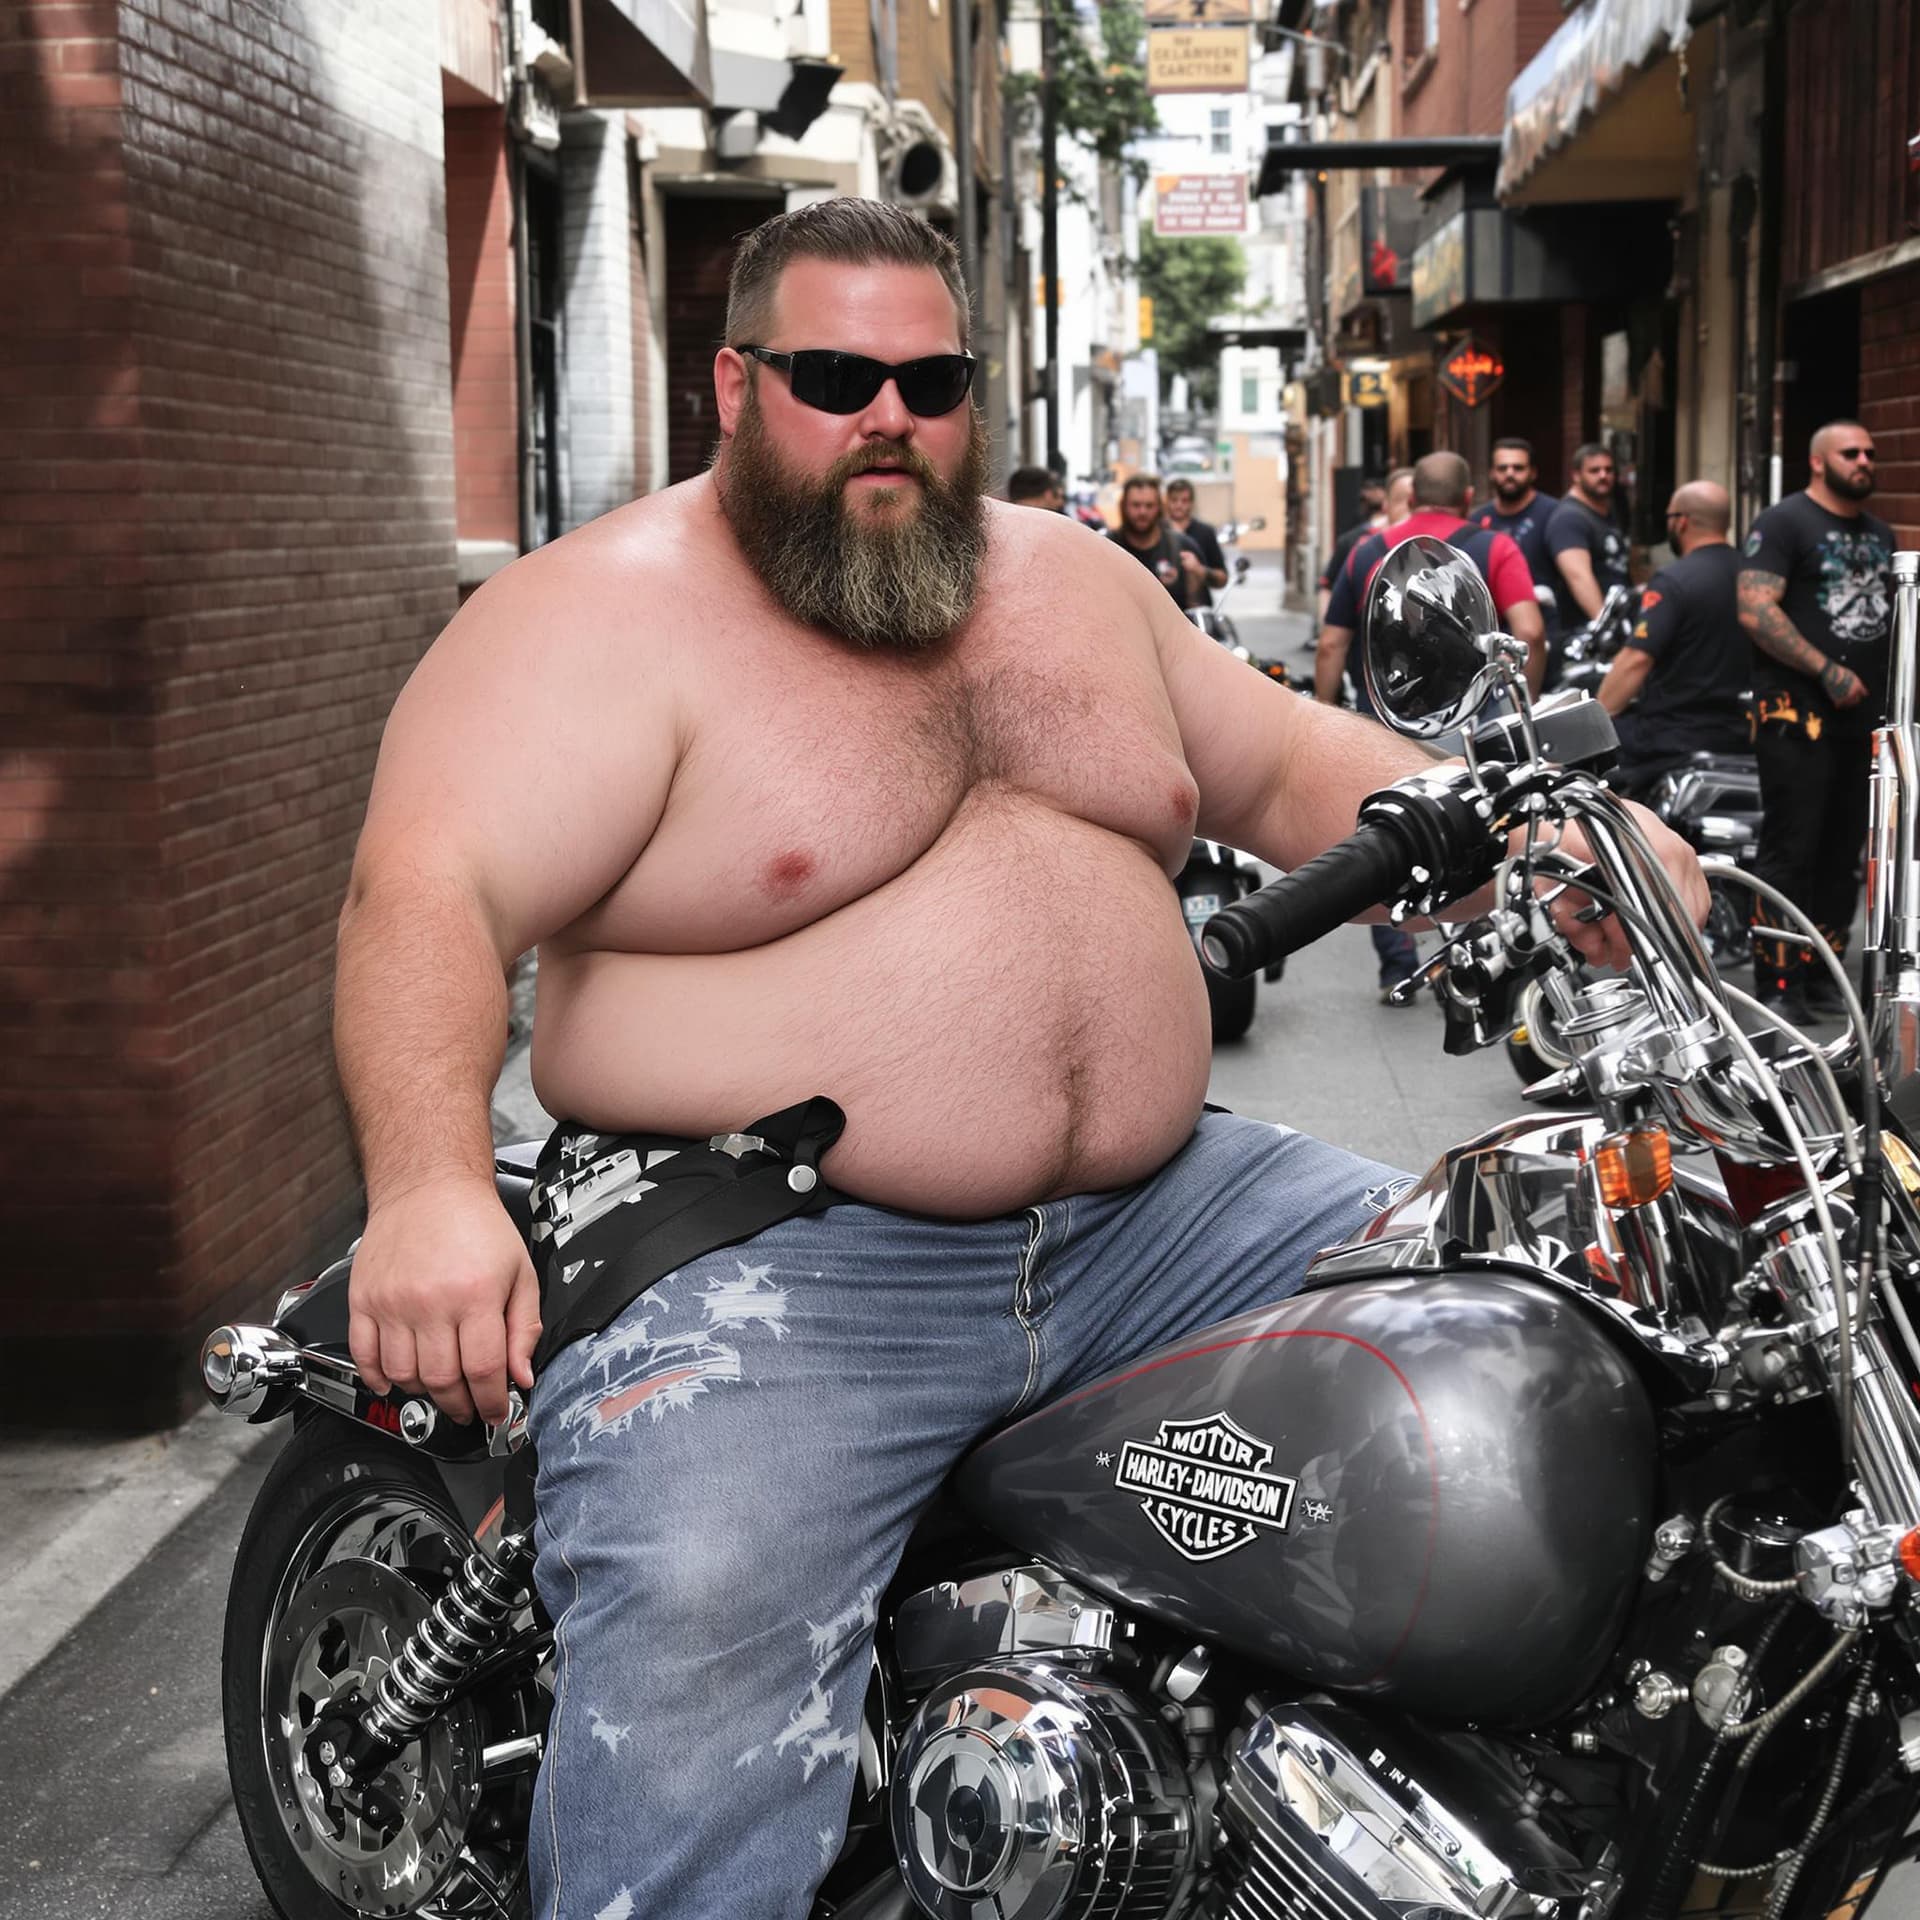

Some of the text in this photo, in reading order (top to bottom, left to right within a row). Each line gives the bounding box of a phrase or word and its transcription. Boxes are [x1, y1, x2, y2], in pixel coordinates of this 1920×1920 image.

[1172, 1425, 1254, 1466] MOTOR
[1125, 1452, 1281, 1516] HARLEY-DAVIDSON
[1157, 1502, 1237, 1549] CYCLES
